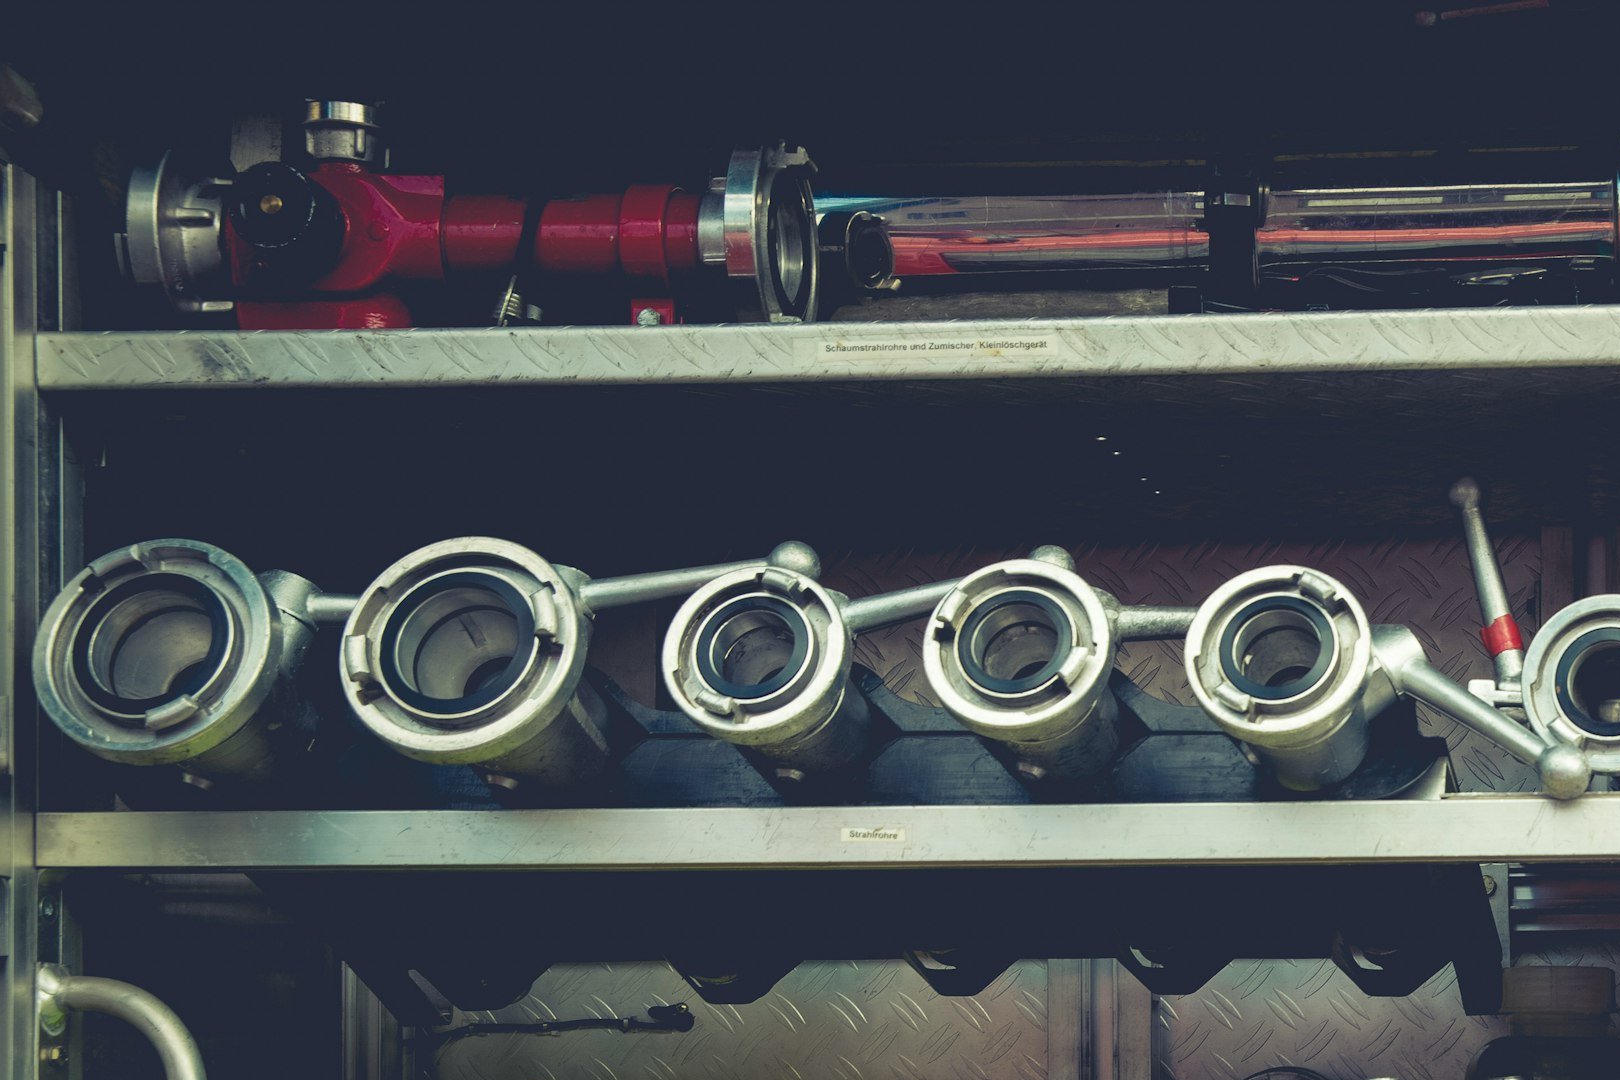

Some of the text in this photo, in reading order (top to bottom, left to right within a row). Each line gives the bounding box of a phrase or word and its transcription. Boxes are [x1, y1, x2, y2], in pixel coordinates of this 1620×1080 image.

[825, 342, 908, 353] Schaumstrahlrohre
[910, 342, 927, 351] und
[979, 340, 1048, 351] Kleinlöschgerät
[849, 830, 898, 840] Strahlrohre
